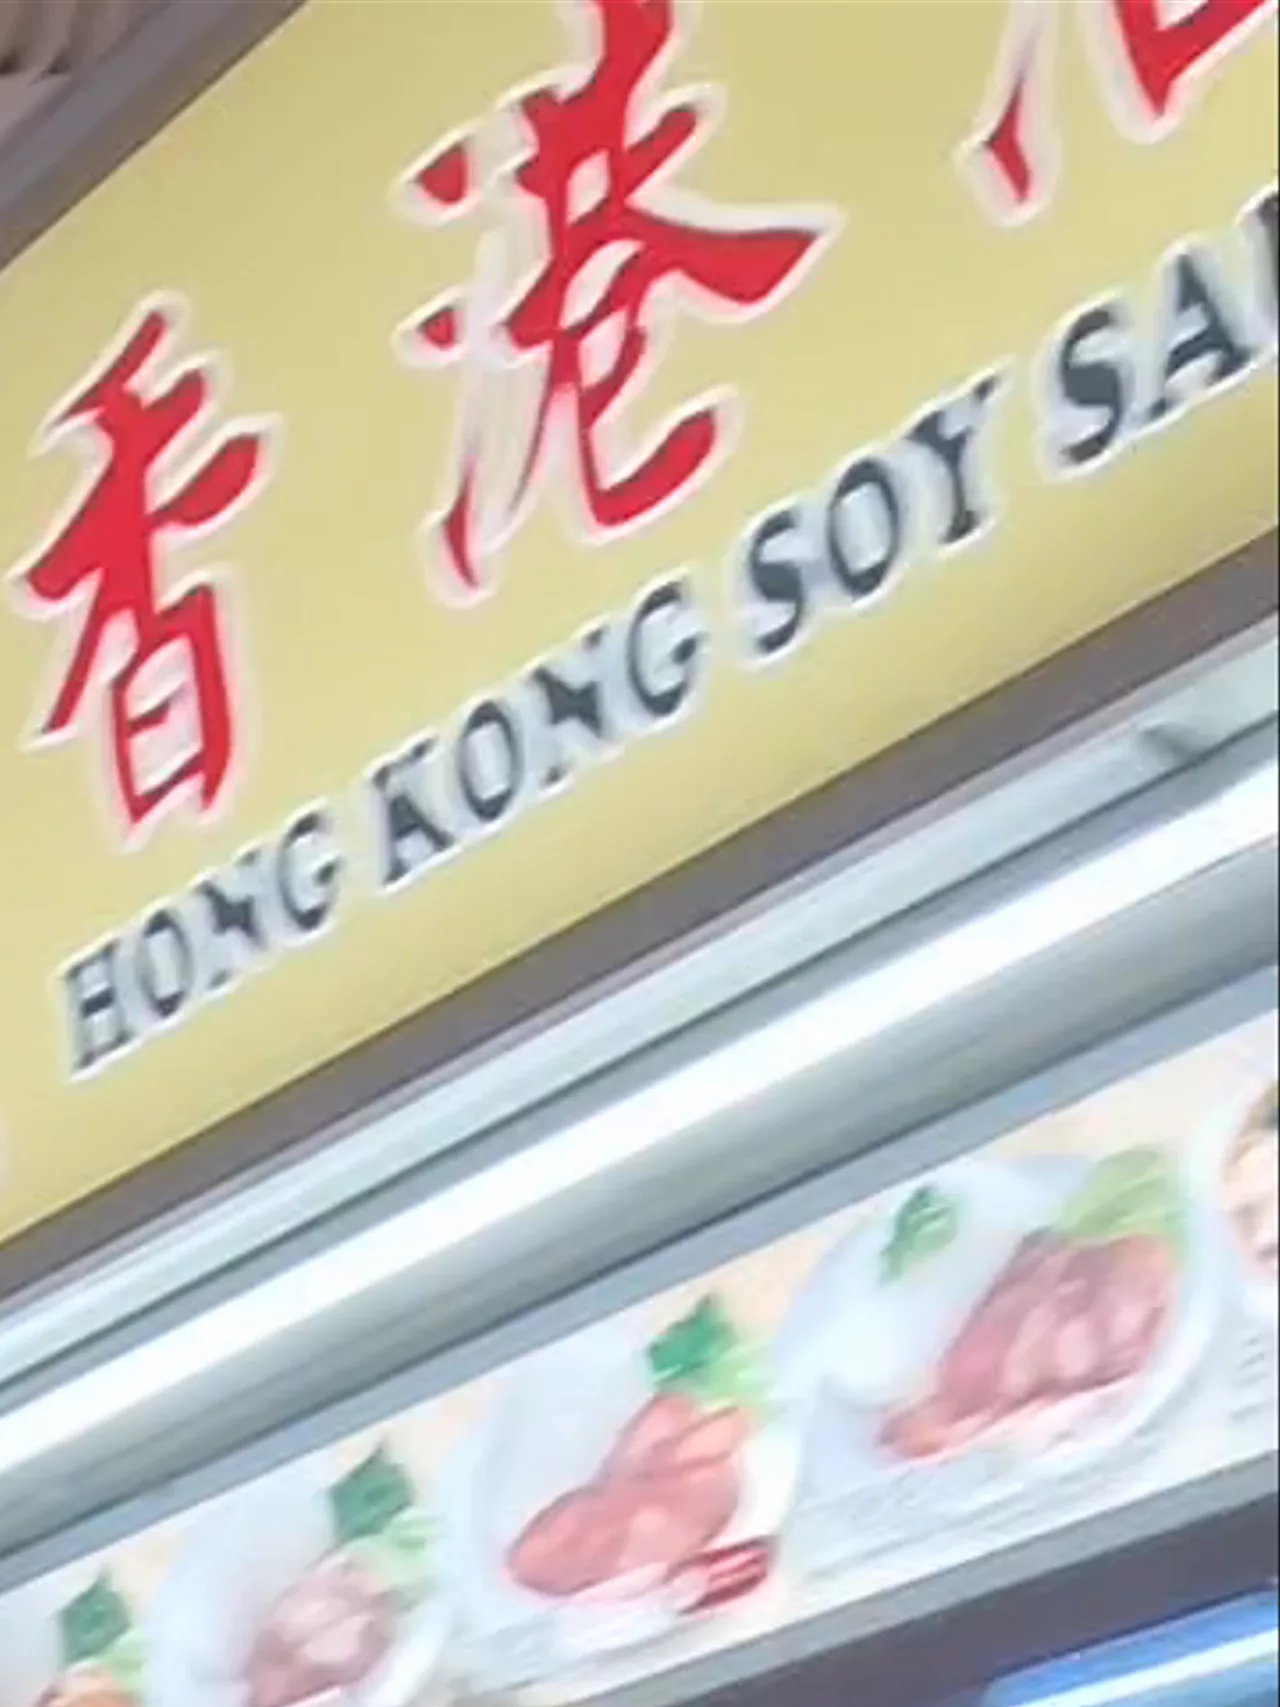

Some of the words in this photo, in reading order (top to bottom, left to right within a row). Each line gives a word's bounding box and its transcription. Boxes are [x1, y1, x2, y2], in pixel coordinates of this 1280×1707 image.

[60, 810, 342, 1072] HONG
[370, 580, 702, 888] KONG
[748, 372, 1002, 655] SOY
[1058, 192, 1278, 464] SA
